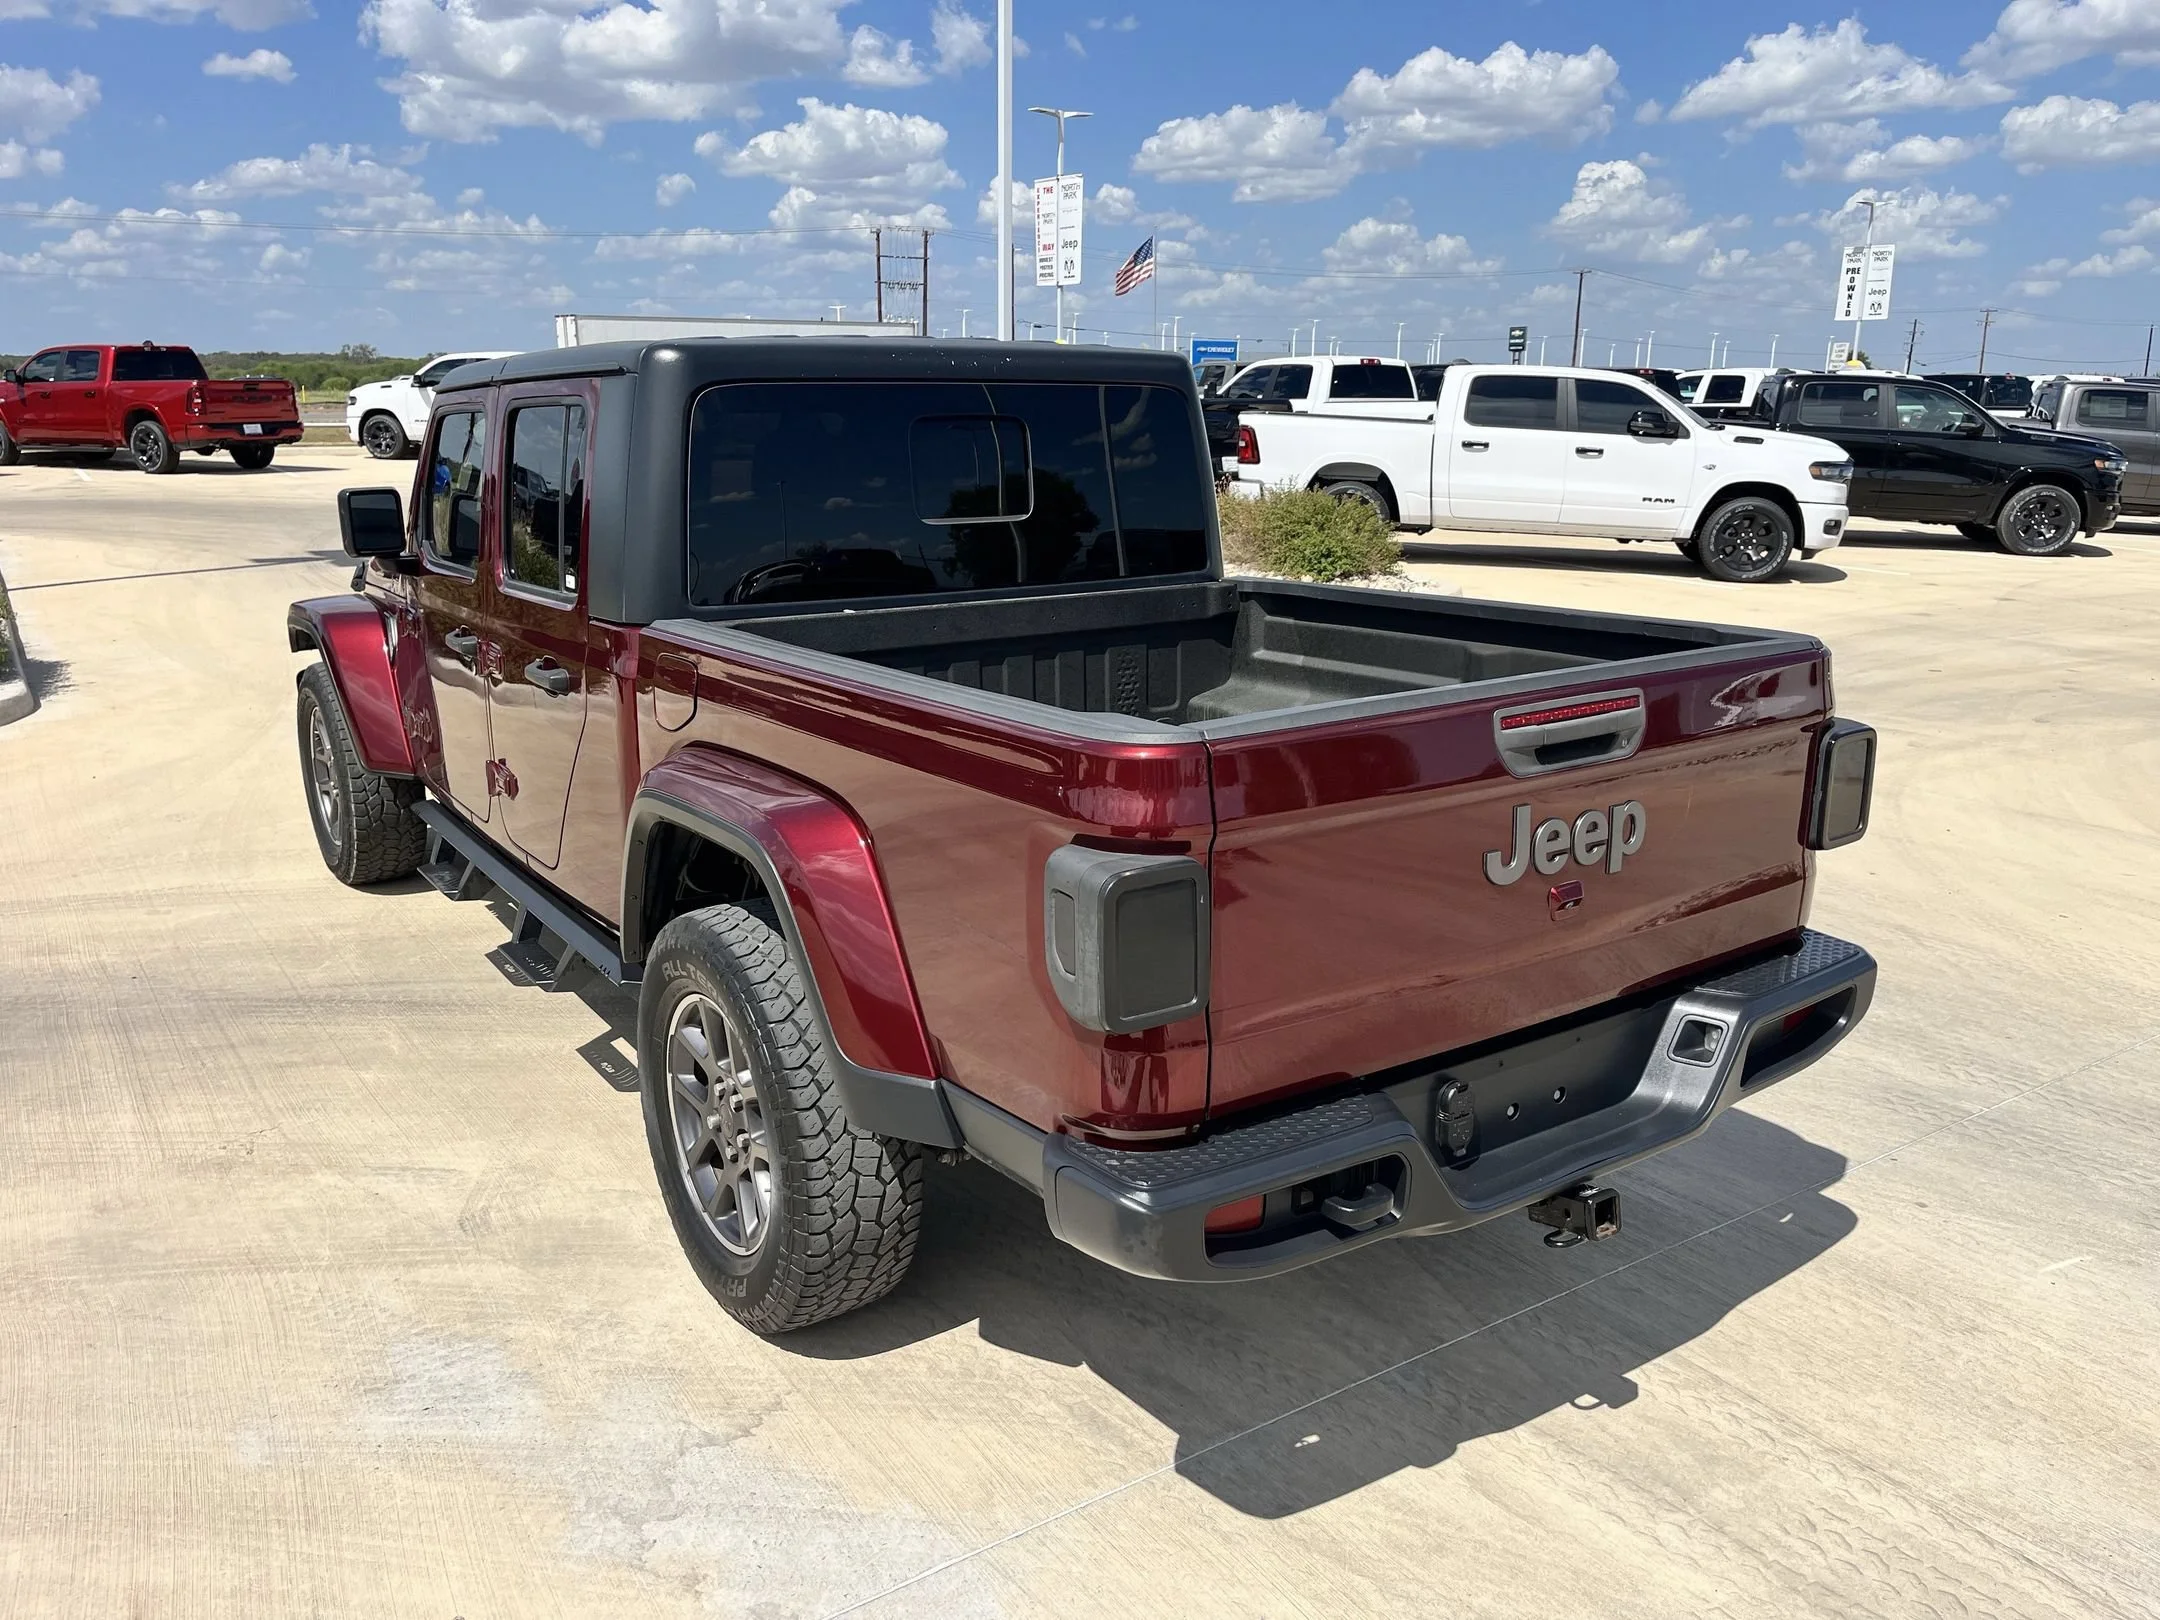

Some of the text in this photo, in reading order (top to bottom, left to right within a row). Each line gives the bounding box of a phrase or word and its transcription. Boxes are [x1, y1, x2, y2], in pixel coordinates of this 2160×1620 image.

[1043, 186, 1054, 195] THE
[1042, 243, 1055, 251] WAY
[1061, 239, 1079, 250] Jeep
[1872, 249, 1893, 257] NORTH
[1846, 267, 1861, 275] PRE
[1844, 276, 1856, 317] OWNED
[1868, 288, 1888, 296] Jeep
[1483, 800, 1647, 886] Jeep
[661, 959, 687, 981] ALL
